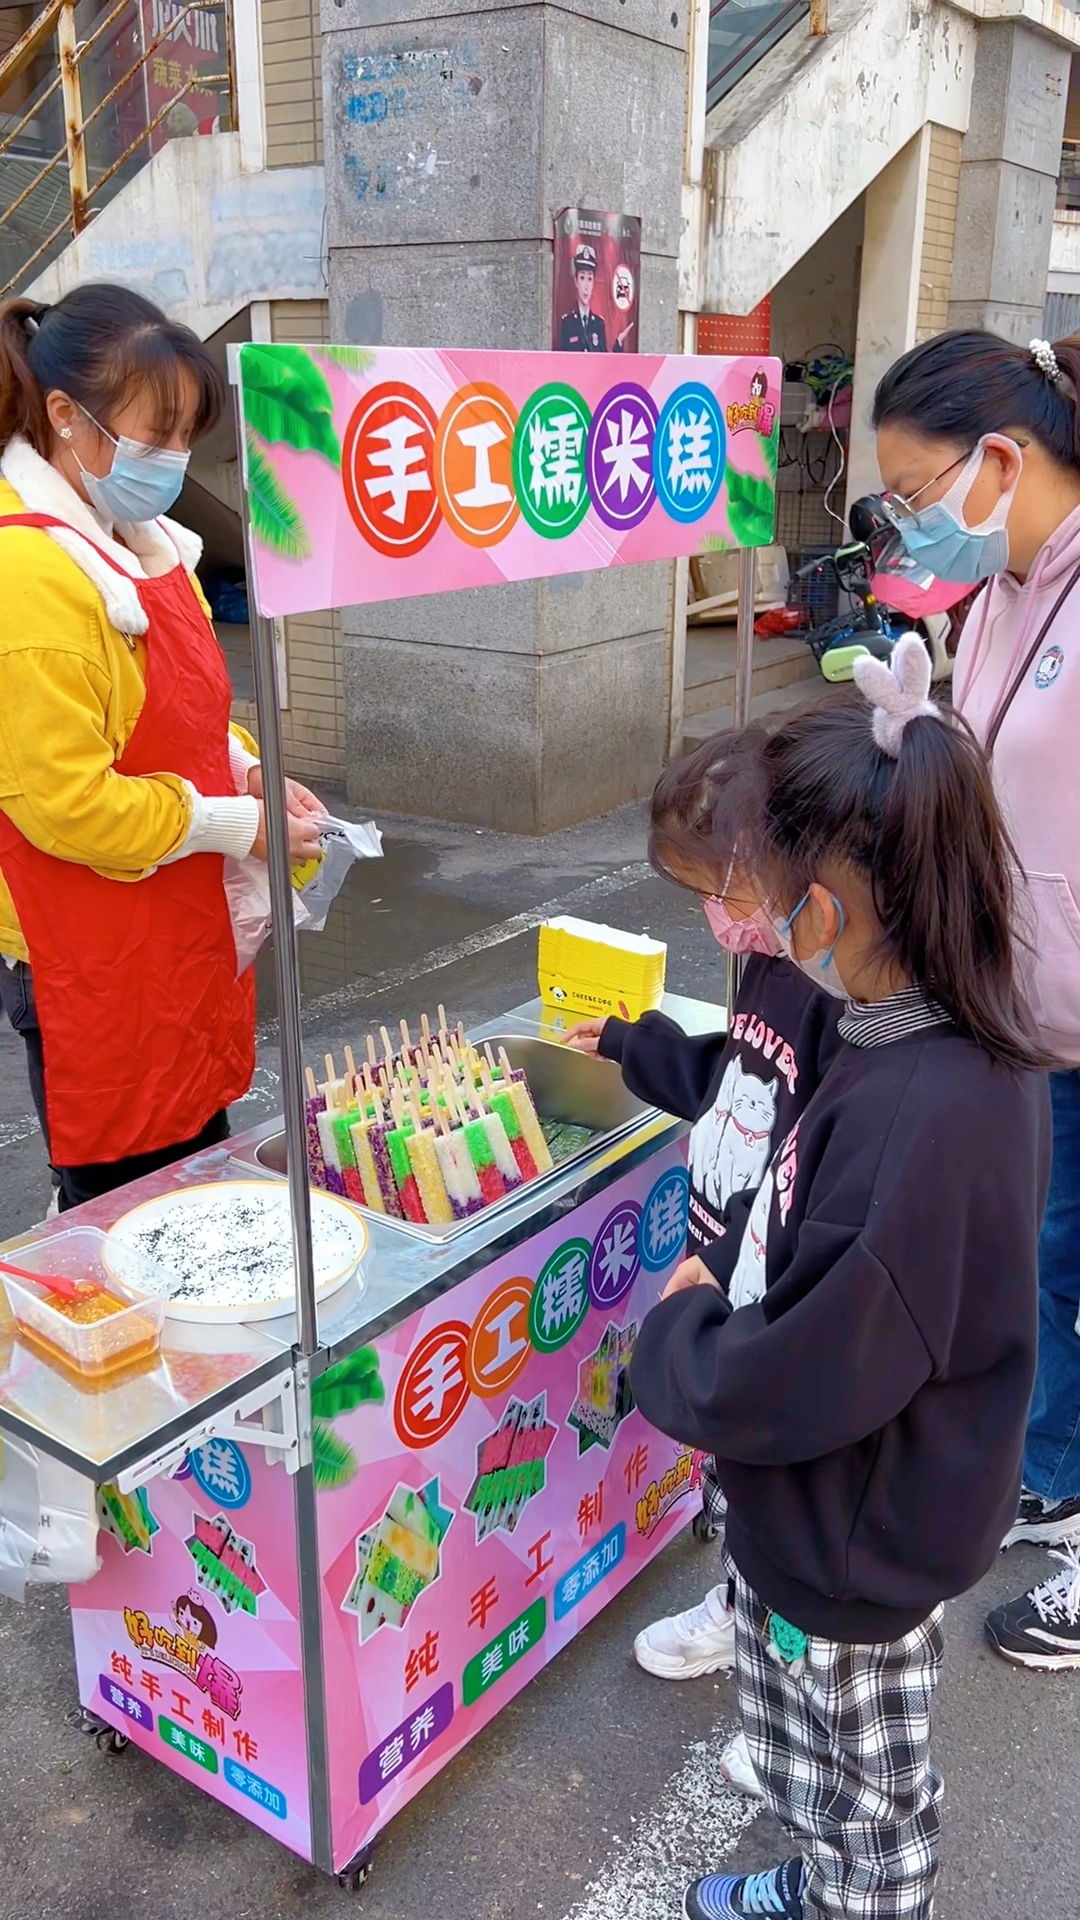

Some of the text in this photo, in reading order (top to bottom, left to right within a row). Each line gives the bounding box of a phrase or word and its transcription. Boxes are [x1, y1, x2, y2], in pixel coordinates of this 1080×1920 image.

[364, 406, 713, 525] 手工糯米糕
[410, 1181, 685, 1420] 手工糯米糕
[404, 1443, 649, 1693] 纯手工制作
[561, 1535, 619, 1603] 零添加
[481, 1618, 530, 1686] 美味
[110, 1685, 142, 1719] 营养
[111, 1650, 258, 1762] 纯手工制作
[171, 1727, 206, 1762] 美味
[379, 1706, 435, 1779] 营养
[230, 1765, 280, 1811] 零添加
